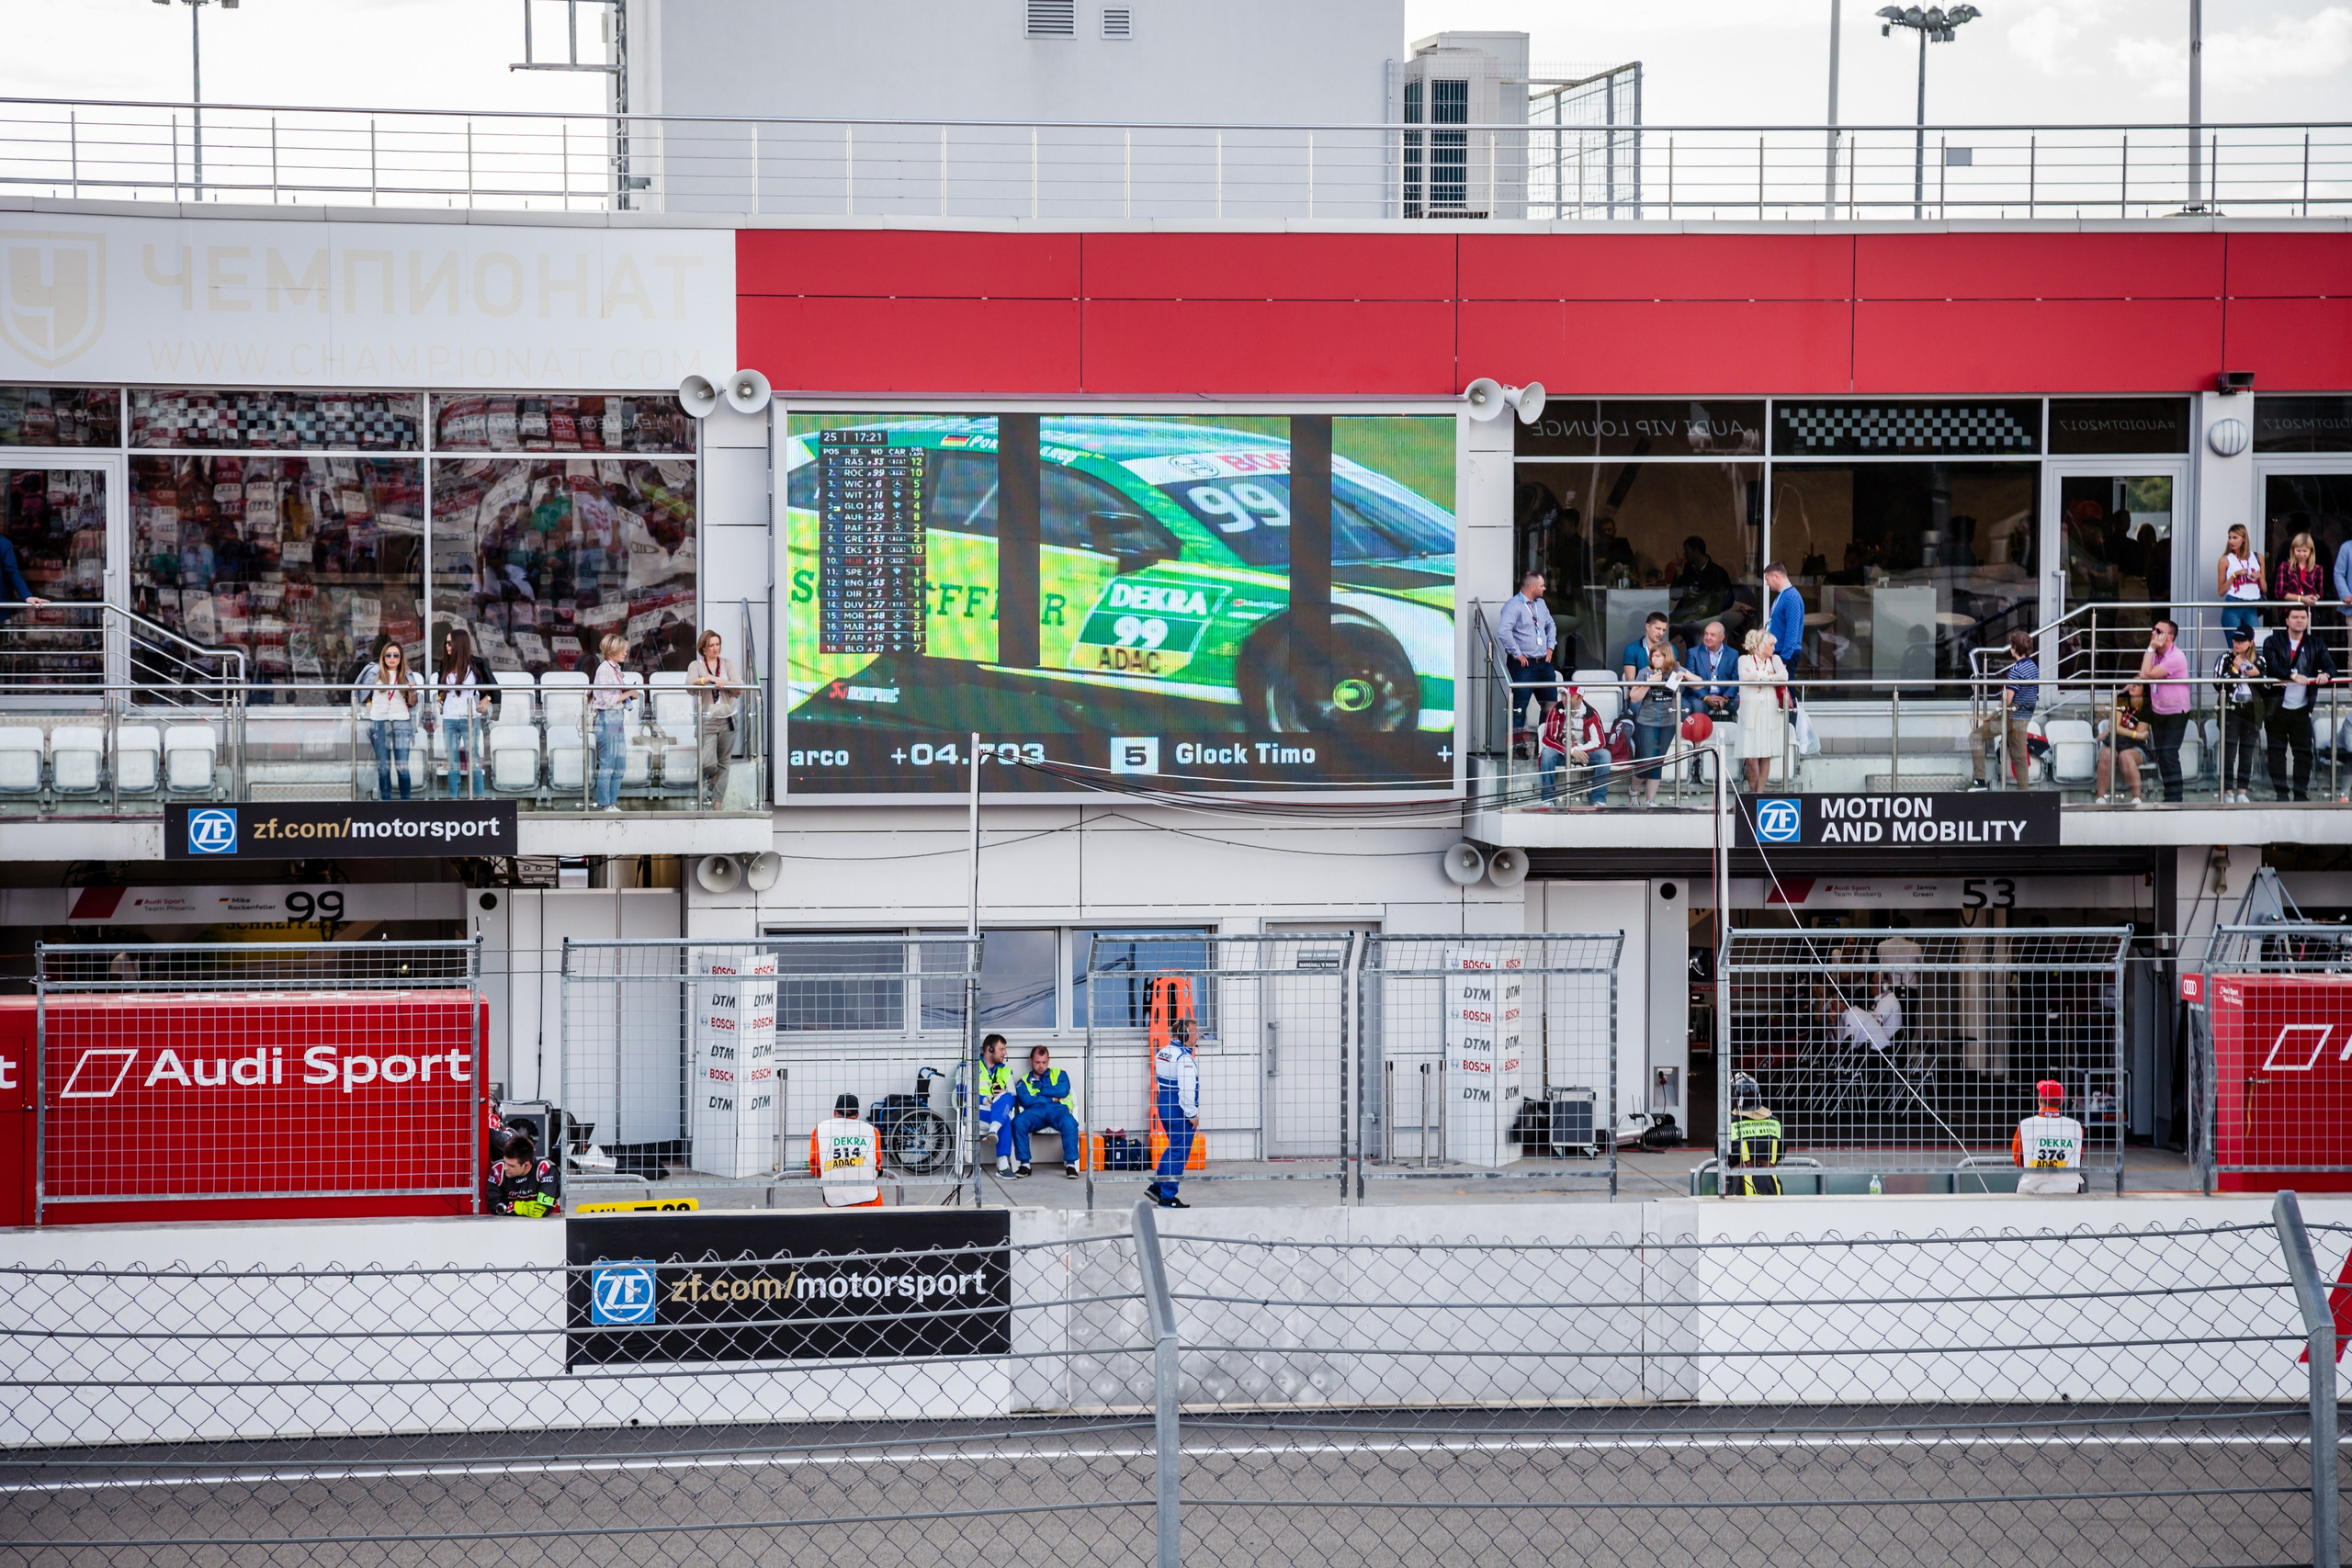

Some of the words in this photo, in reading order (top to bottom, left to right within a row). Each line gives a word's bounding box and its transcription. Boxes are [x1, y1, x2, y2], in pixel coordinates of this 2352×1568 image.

[142, 243, 703, 319] ЧЕМПИОНАТ
[146, 339, 701, 382] WWW.CHAMPIONAT.COM
[823, 433, 837, 442] 25
[854, 432, 882, 442] 17:21
[1187, 482, 1290, 534] 99
[1108, 583, 1207, 615] DEKRA
[1113, 616, 1169, 649] 99
[1100, 647, 1160, 674] ADAC
[791, 746, 849, 766] arco
[1123, 744, 1147, 766] 5
[1176, 741, 1249, 766] Glock
[1254, 741, 1316, 766] Timo
[1820, 797, 1933, 818] MOTION
[1765, 808, 1792, 829] ZF
[196, 820, 229, 840] ZF
[253, 817, 500, 840] zf.com/motorsport
[1820, 820, 1883, 842] AND
[1892, 820, 2027, 842] MOBILITY
[164, 897, 186, 906] Sport
[1962, 879, 2015, 908] 53
[285, 890, 344, 922] 99
[753, 992, 774, 1008] DTM
[1463, 987, 1491, 1001] DTM
[1505, 985, 1520, 999] DTM
[712, 993, 736, 1009] DTM
[1463, 1010, 1491, 1023] BOSCH
[1505, 1008, 1520, 1021] BOSCH
[711, 1017, 735, 1031] BOSCH
[753, 1016, 774, 1030] BOSCH
[752, 1043, 772, 1059] DTM
[1463, 1037, 1491, 1052] DTM
[1505, 1035, 1520, 1051] DTM
[710, 1044, 734, 1060] DTM
[143, 1047, 283, 1088] Audi
[303, 1045, 471, 1093] Sport
[1463, 1060, 1490, 1073] BOSCH
[1505, 1058, 1520, 1071] BOSCH
[709, 1068, 734, 1082] BOSCH
[752, 1067, 771, 1081] BOSCH
[1463, 1088, 1490, 1102] DTM
[1505, 1085, 1520, 1100] DTM
[709, 1096, 732, 1111] DTM
[752, 1095, 771, 1110] DTM
[833, 1136, 867, 1146] DEKRA
[2040, 1138, 2073, 1149] DEKRA
[832, 1147, 861, 1159] 514
[2037, 1149, 2066, 1160] 376
[832, 1157, 856, 1169] ADAC
[2036, 1160, 2058, 1168] ADAC
[606, 1274, 644, 1308] ZF
[671, 1268, 986, 1304] zf.com/motorsport
